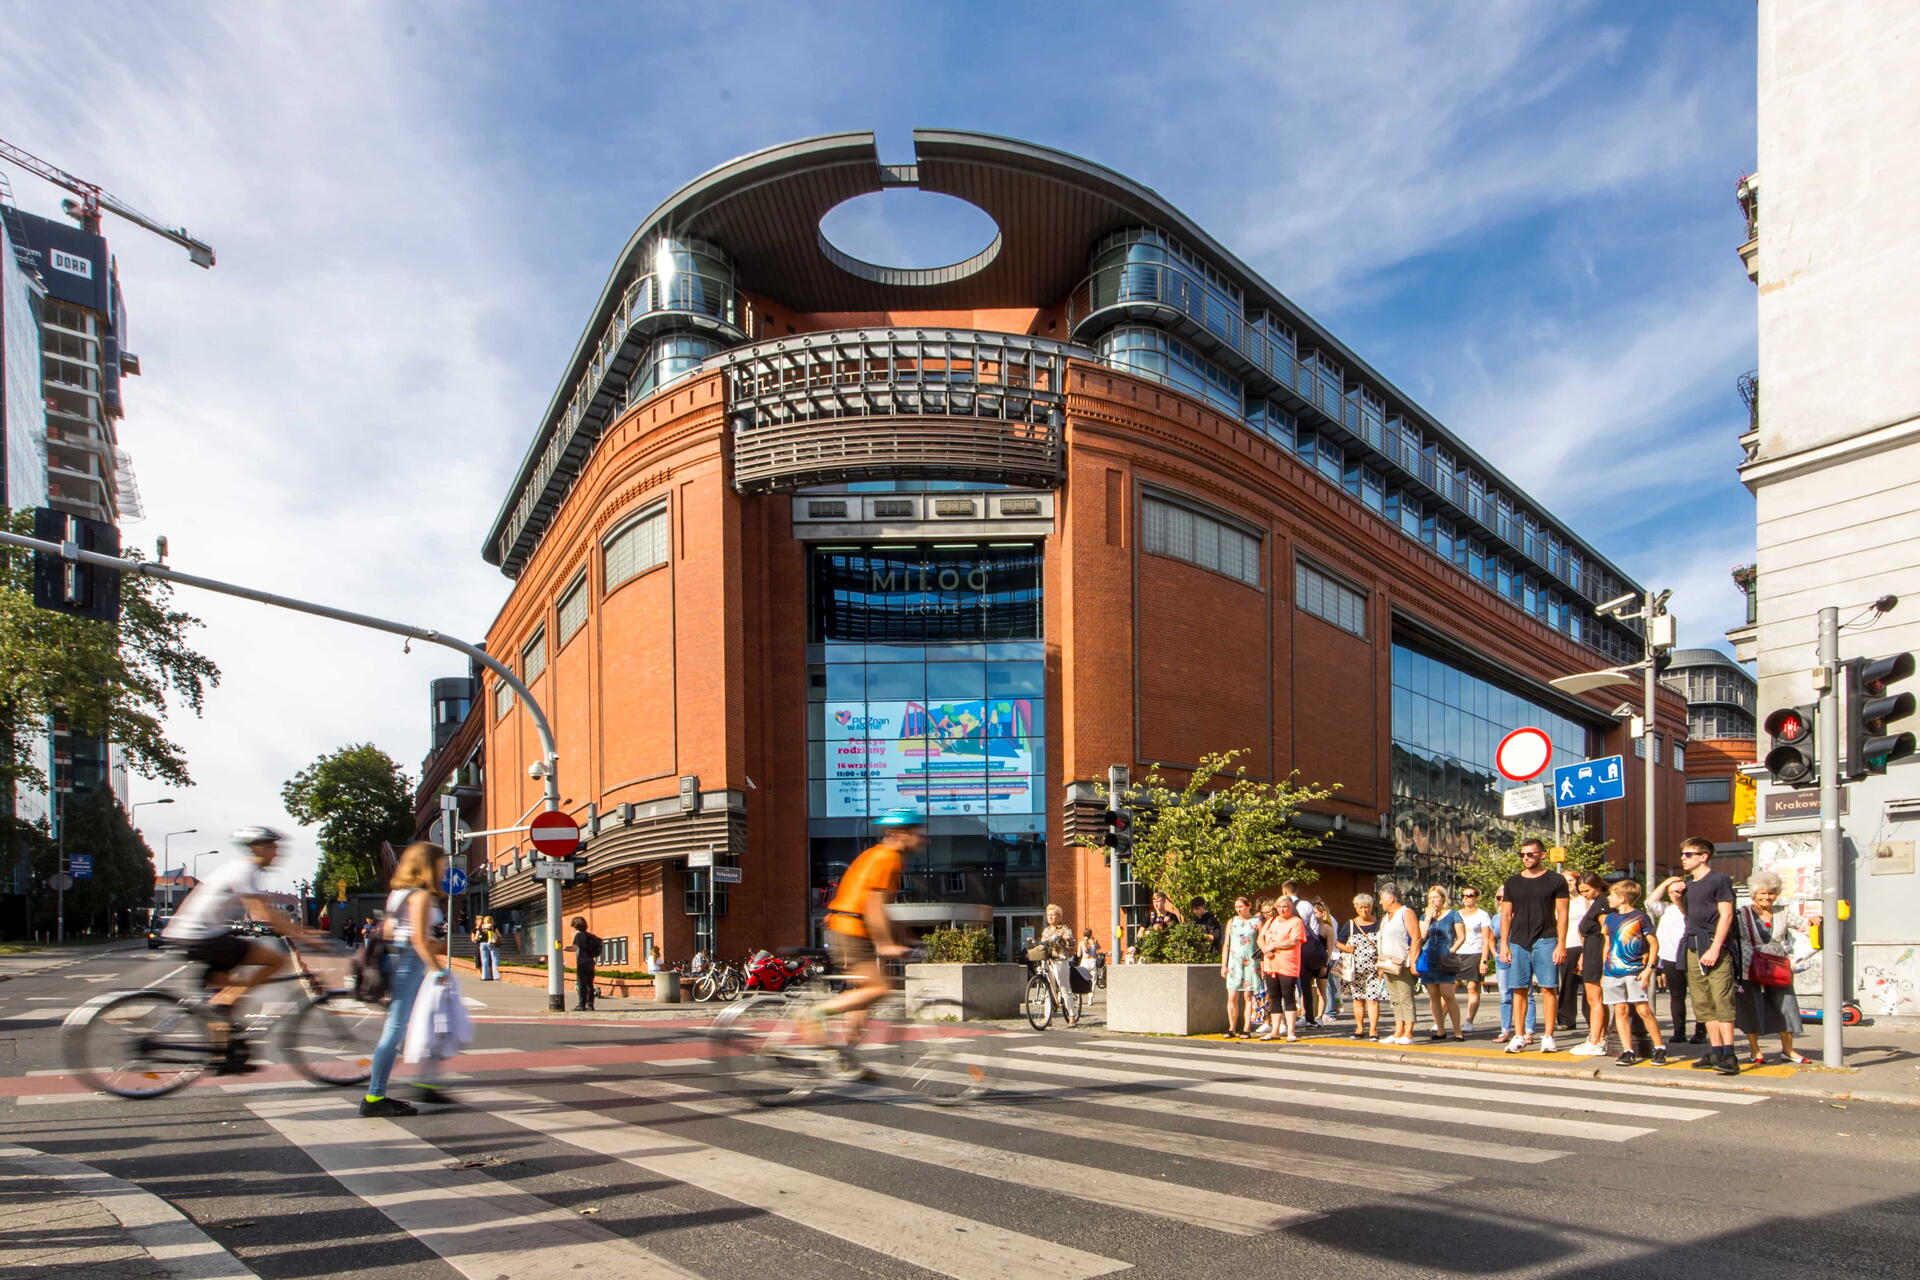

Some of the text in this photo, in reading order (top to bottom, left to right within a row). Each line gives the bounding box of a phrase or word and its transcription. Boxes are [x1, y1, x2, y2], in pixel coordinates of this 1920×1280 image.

[872, 568, 989, 592] MILOO
[905, 604, 960, 615] HOME
[847, 761, 887, 769] wrzenia
